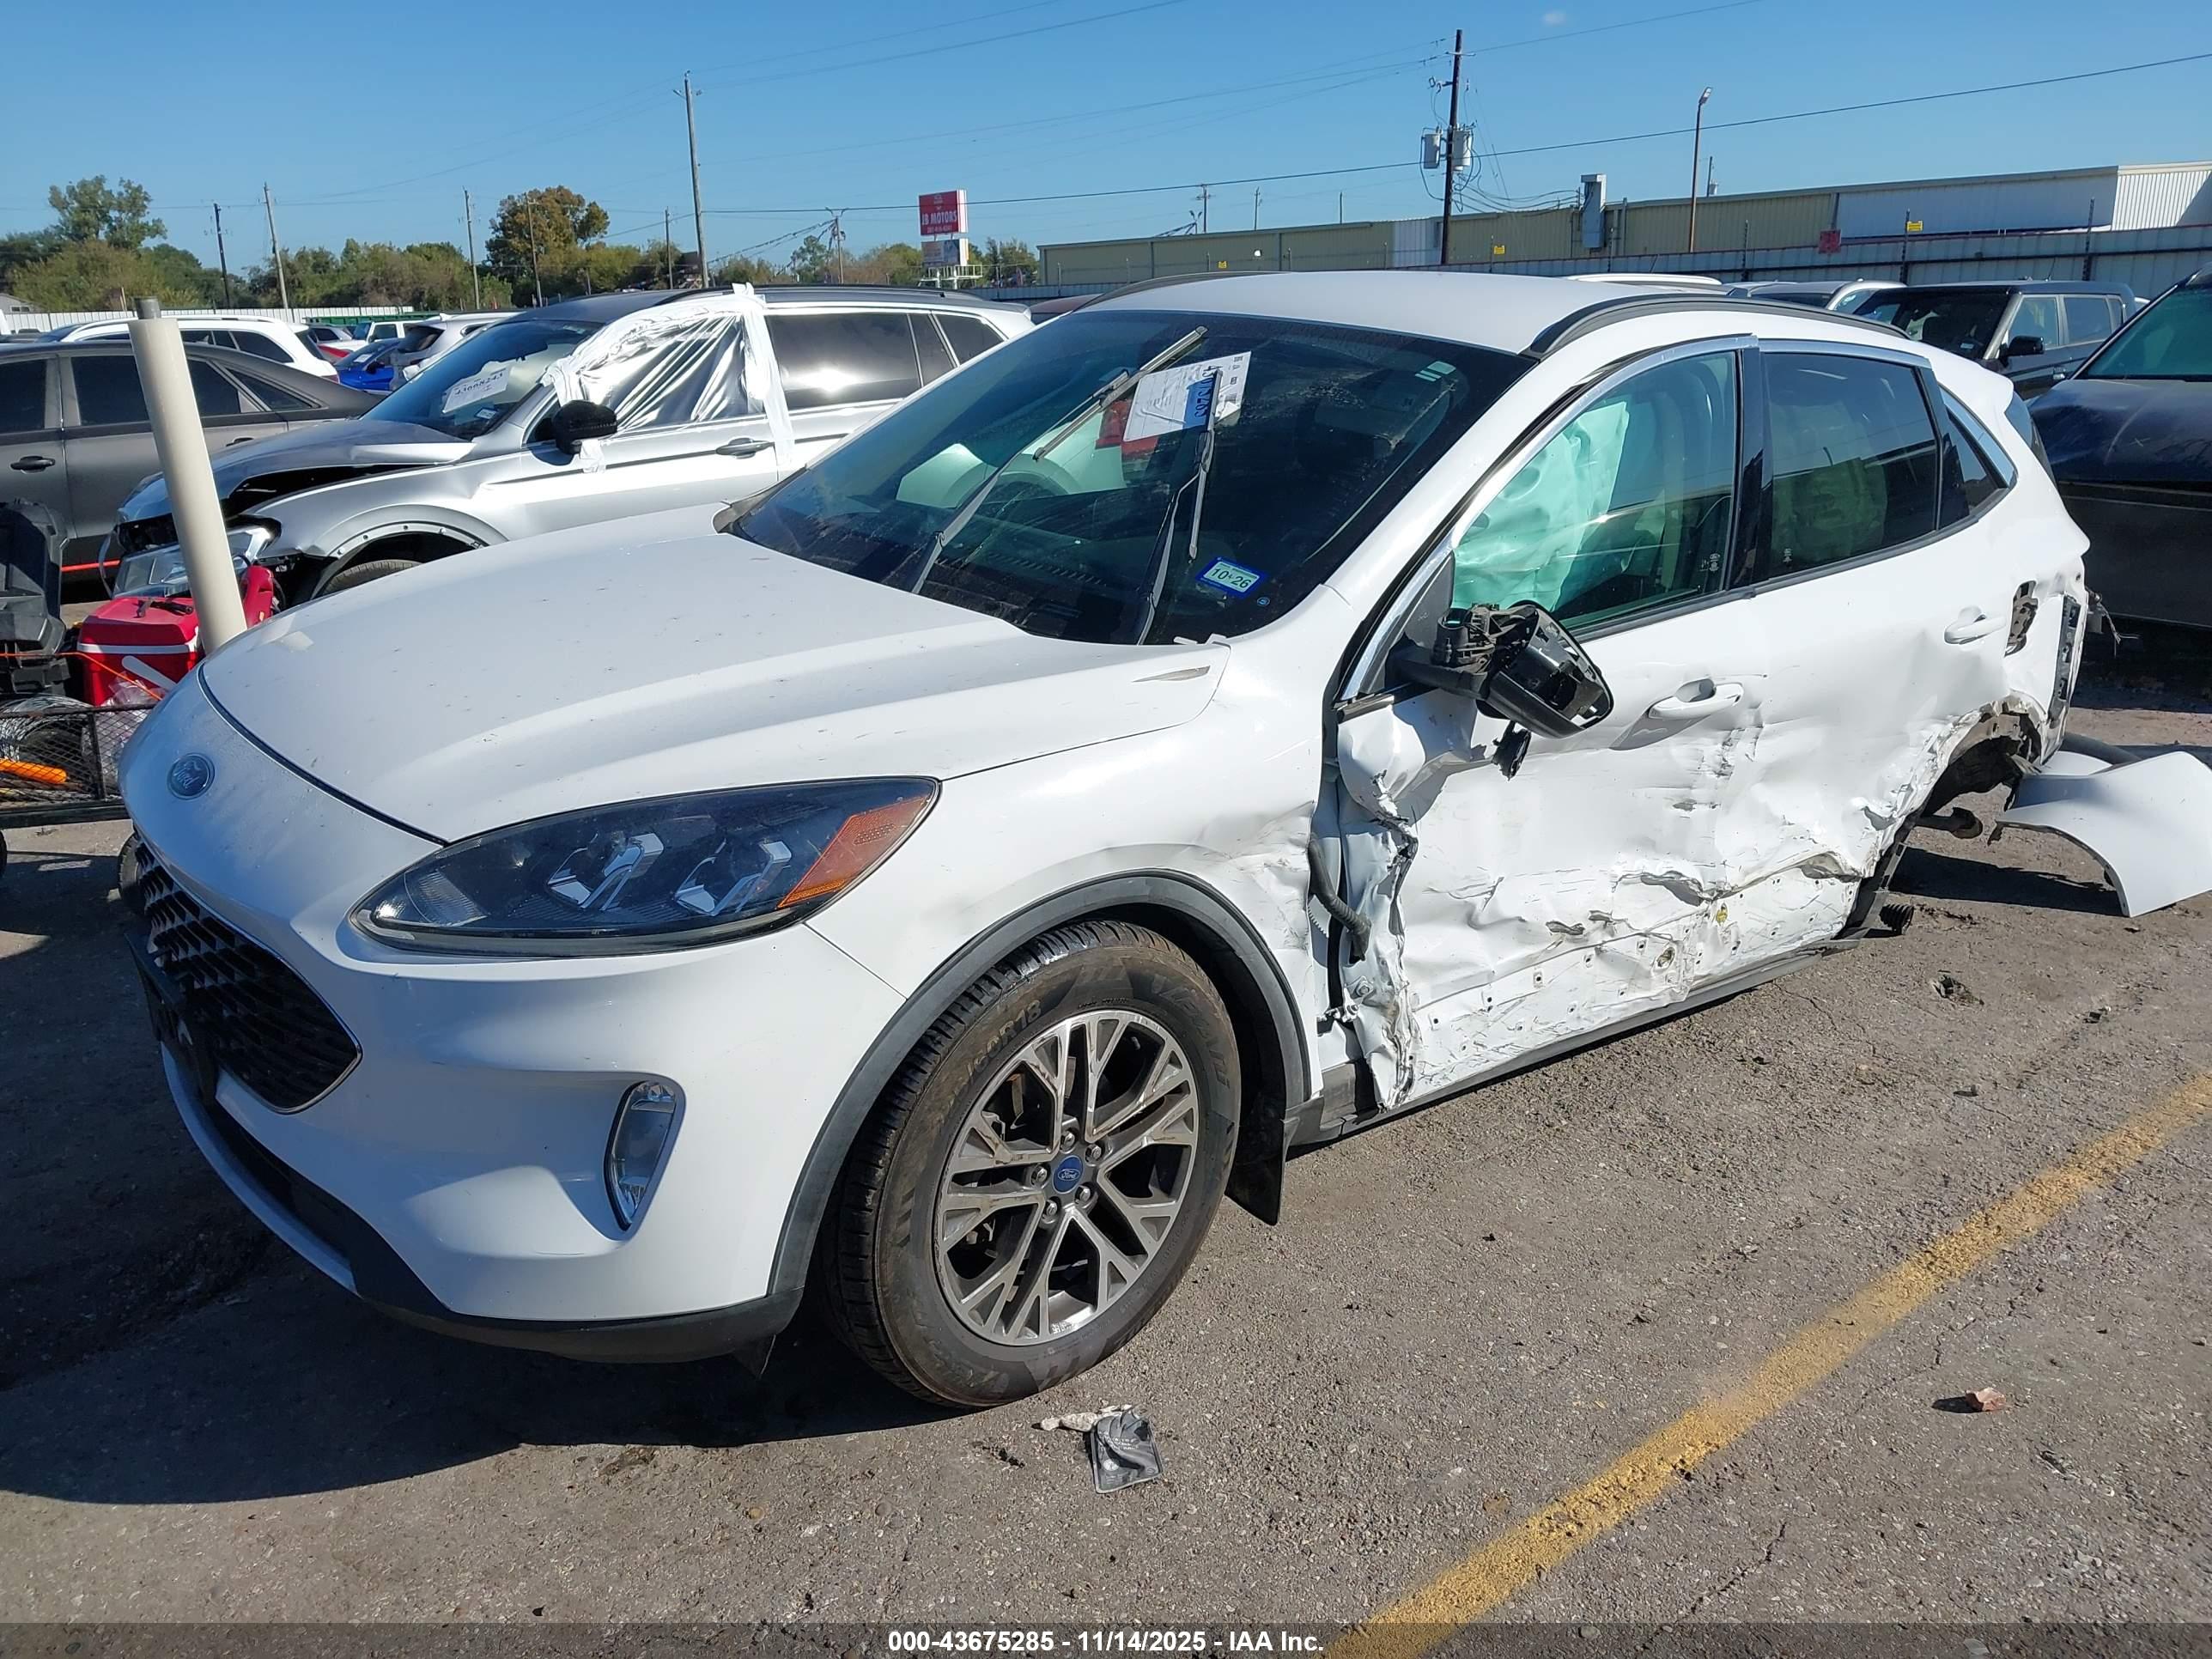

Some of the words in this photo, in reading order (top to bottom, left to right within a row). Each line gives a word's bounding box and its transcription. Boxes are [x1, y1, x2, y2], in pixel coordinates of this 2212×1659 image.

[930, 210, 957, 225] MOTORS
[1211, 568, 1230, 580] 10
[1231, 576, 1252, 588] 26
[1060, 1170, 1078, 1179] Ford
